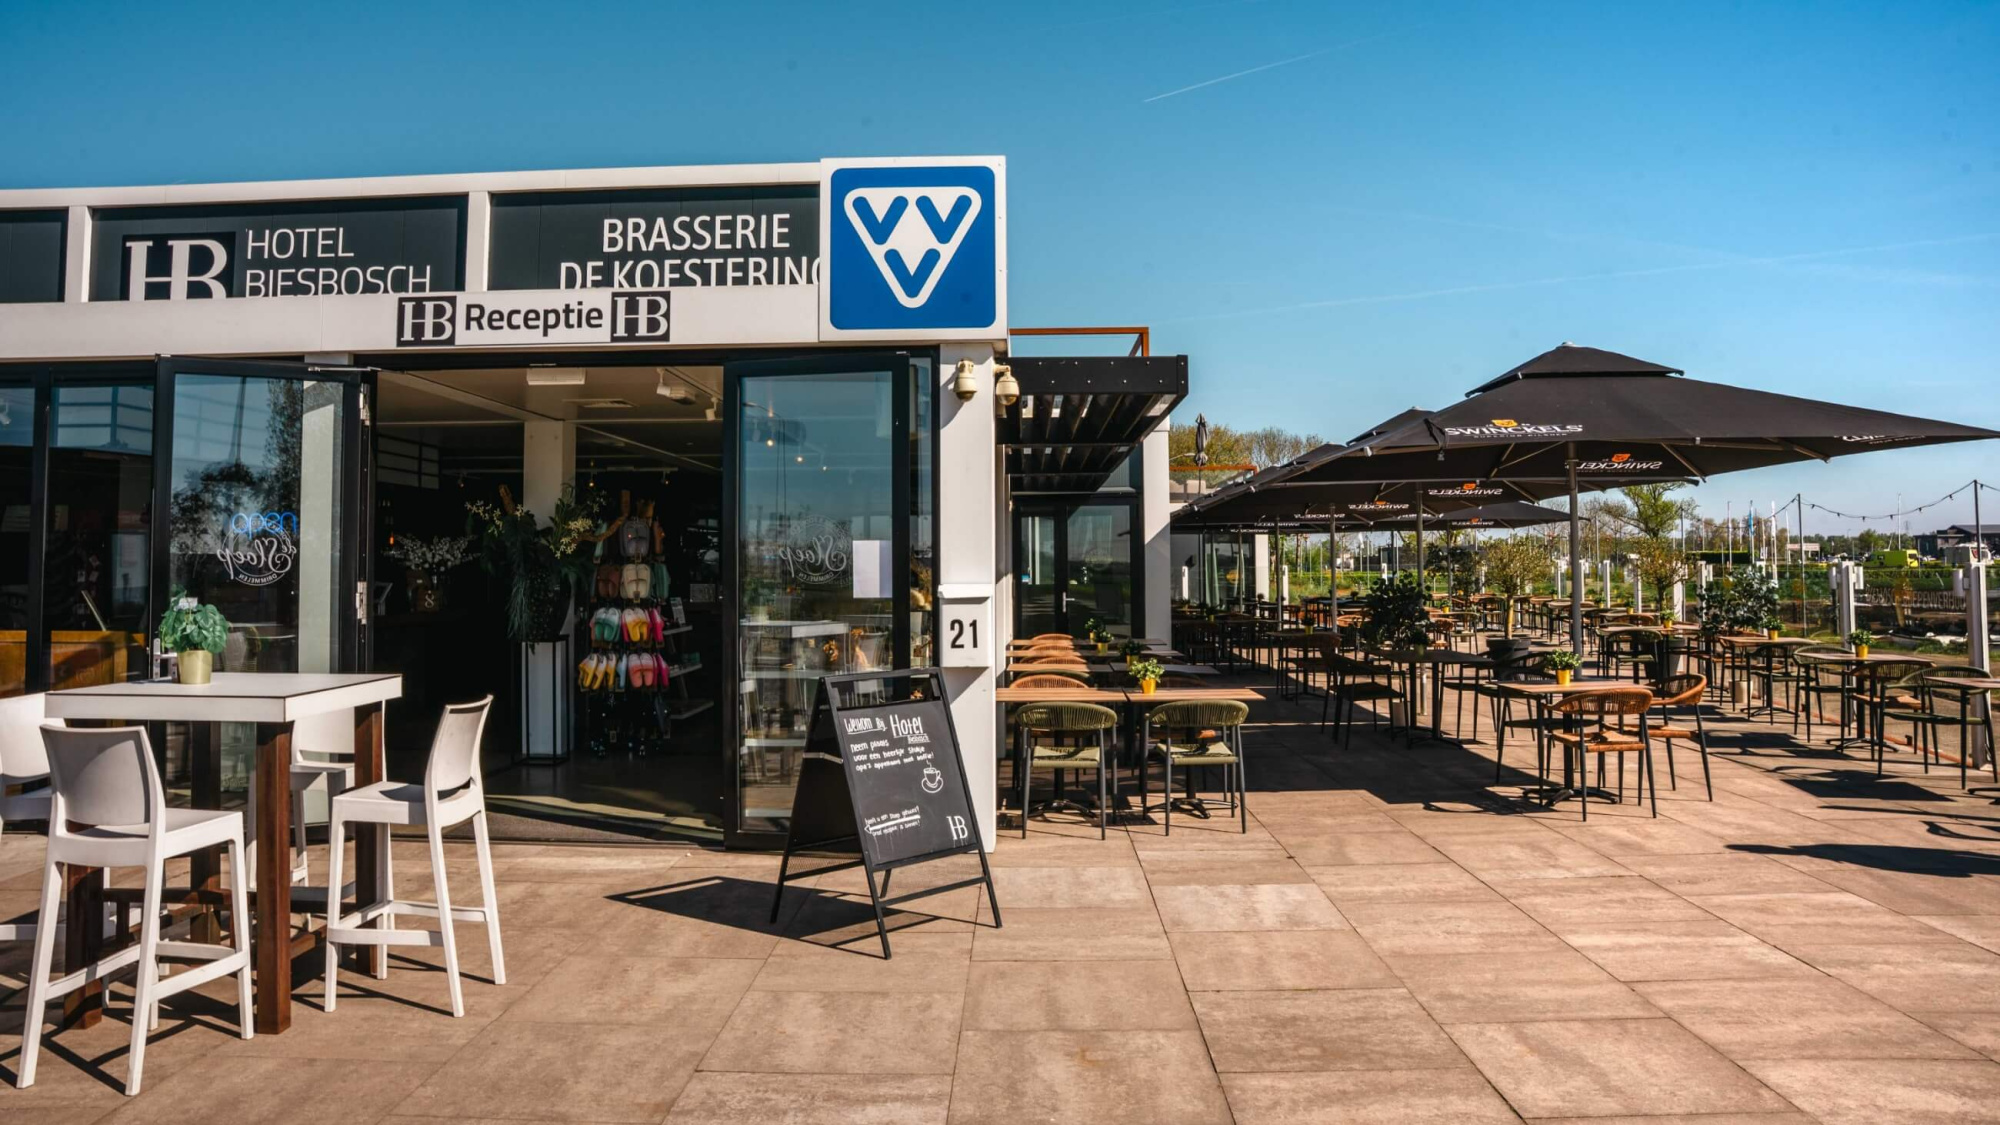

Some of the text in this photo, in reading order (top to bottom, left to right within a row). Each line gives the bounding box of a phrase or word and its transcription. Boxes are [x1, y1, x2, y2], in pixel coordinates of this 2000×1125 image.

[246, 227, 354, 259] HOTEL
[603, 213, 790, 252] BRASSERIE
[126, 239, 237, 300] HB
[246, 265, 431, 297] BIESBOSCH
[560, 261, 604, 290] DE
[400, 296, 669, 341] HB Receptie HB
[231, 512, 297, 540] open
[949, 619, 978, 649] 21
[889, 713, 923, 737] Hotel
[946, 815, 968, 840] HB
